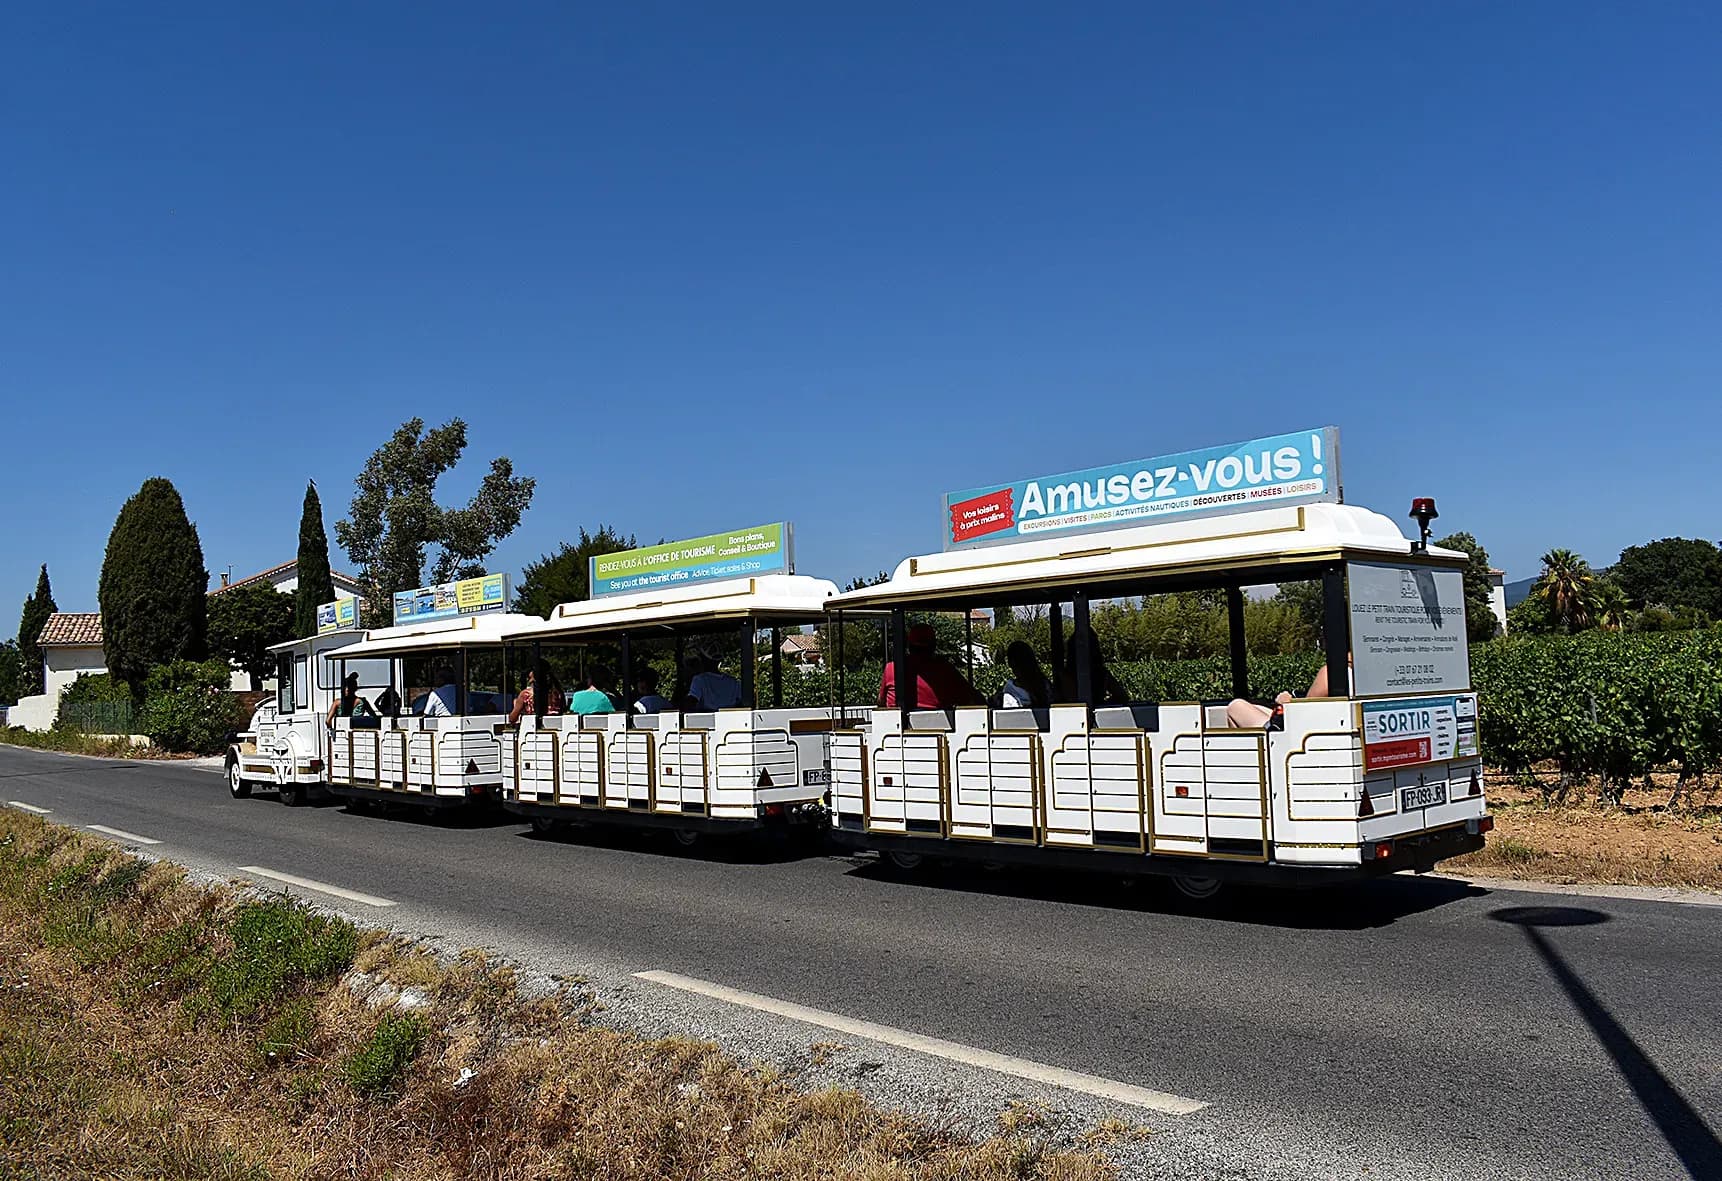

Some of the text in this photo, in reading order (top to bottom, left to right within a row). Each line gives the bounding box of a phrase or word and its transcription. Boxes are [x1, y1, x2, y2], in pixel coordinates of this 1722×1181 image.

[962, 503, 1000, 519] Vos loisirs
[1063, 514, 1088, 525] VISITES
[1090, 511, 1112, 521] PARCS
[1149, 499, 1190, 513] NAUTIQUES
[1192, 491, 1247, 506] DÉCOUVERTES
[1250, 486, 1283, 498] MUSÉES
[1286, 482, 1317, 494] LOISIRS
[965, 516, 981, 529] prix
[670, 551, 680, 561] DE
[680, 544, 716, 559] TOURISME
[610, 580, 621, 590] See
[638, 575, 649, 585] the
[1378, 710, 1431, 734] SORTIR
